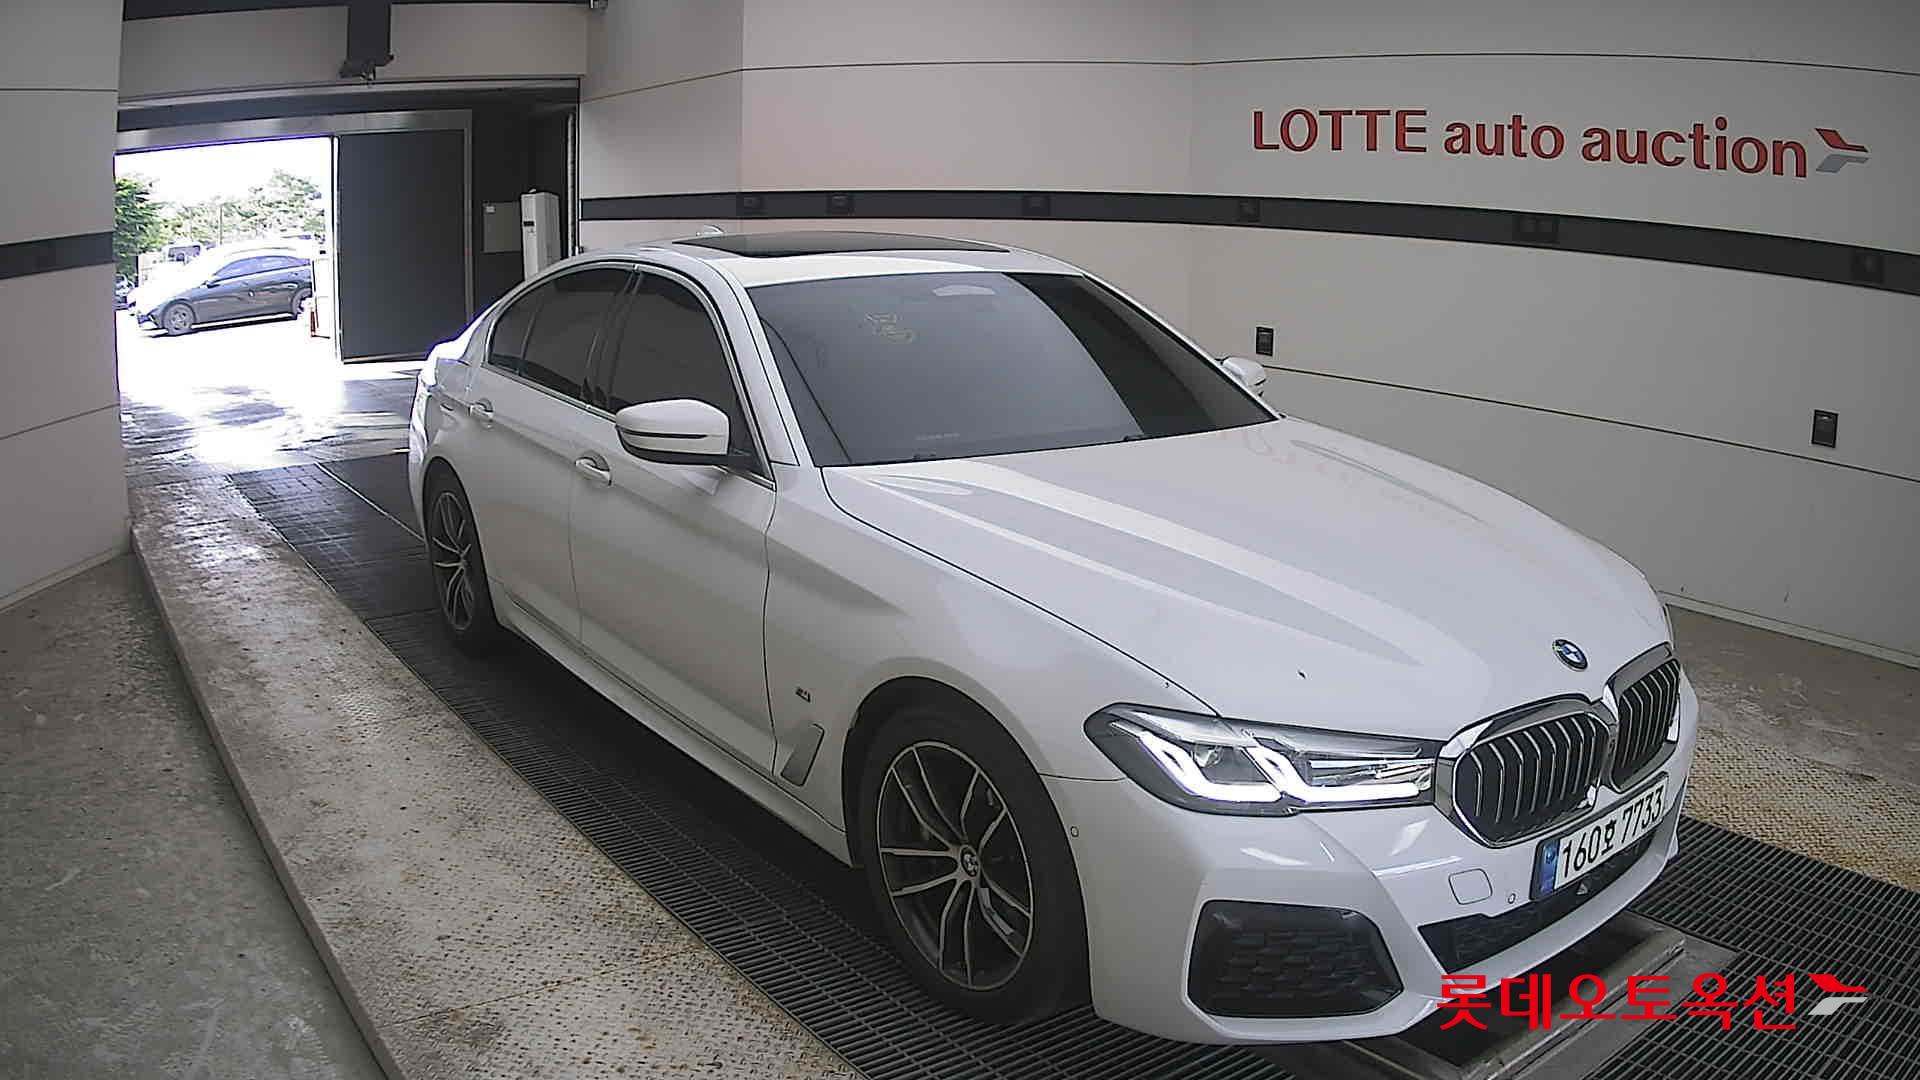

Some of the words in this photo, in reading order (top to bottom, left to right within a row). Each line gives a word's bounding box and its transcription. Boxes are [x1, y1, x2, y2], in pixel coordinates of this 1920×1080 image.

[1253, 109, 1428, 153] LOTTE
[1443, 114, 1565, 160] auto
[1582, 116, 1808, 178] auction
[1621, 785, 1664, 844] 7733
